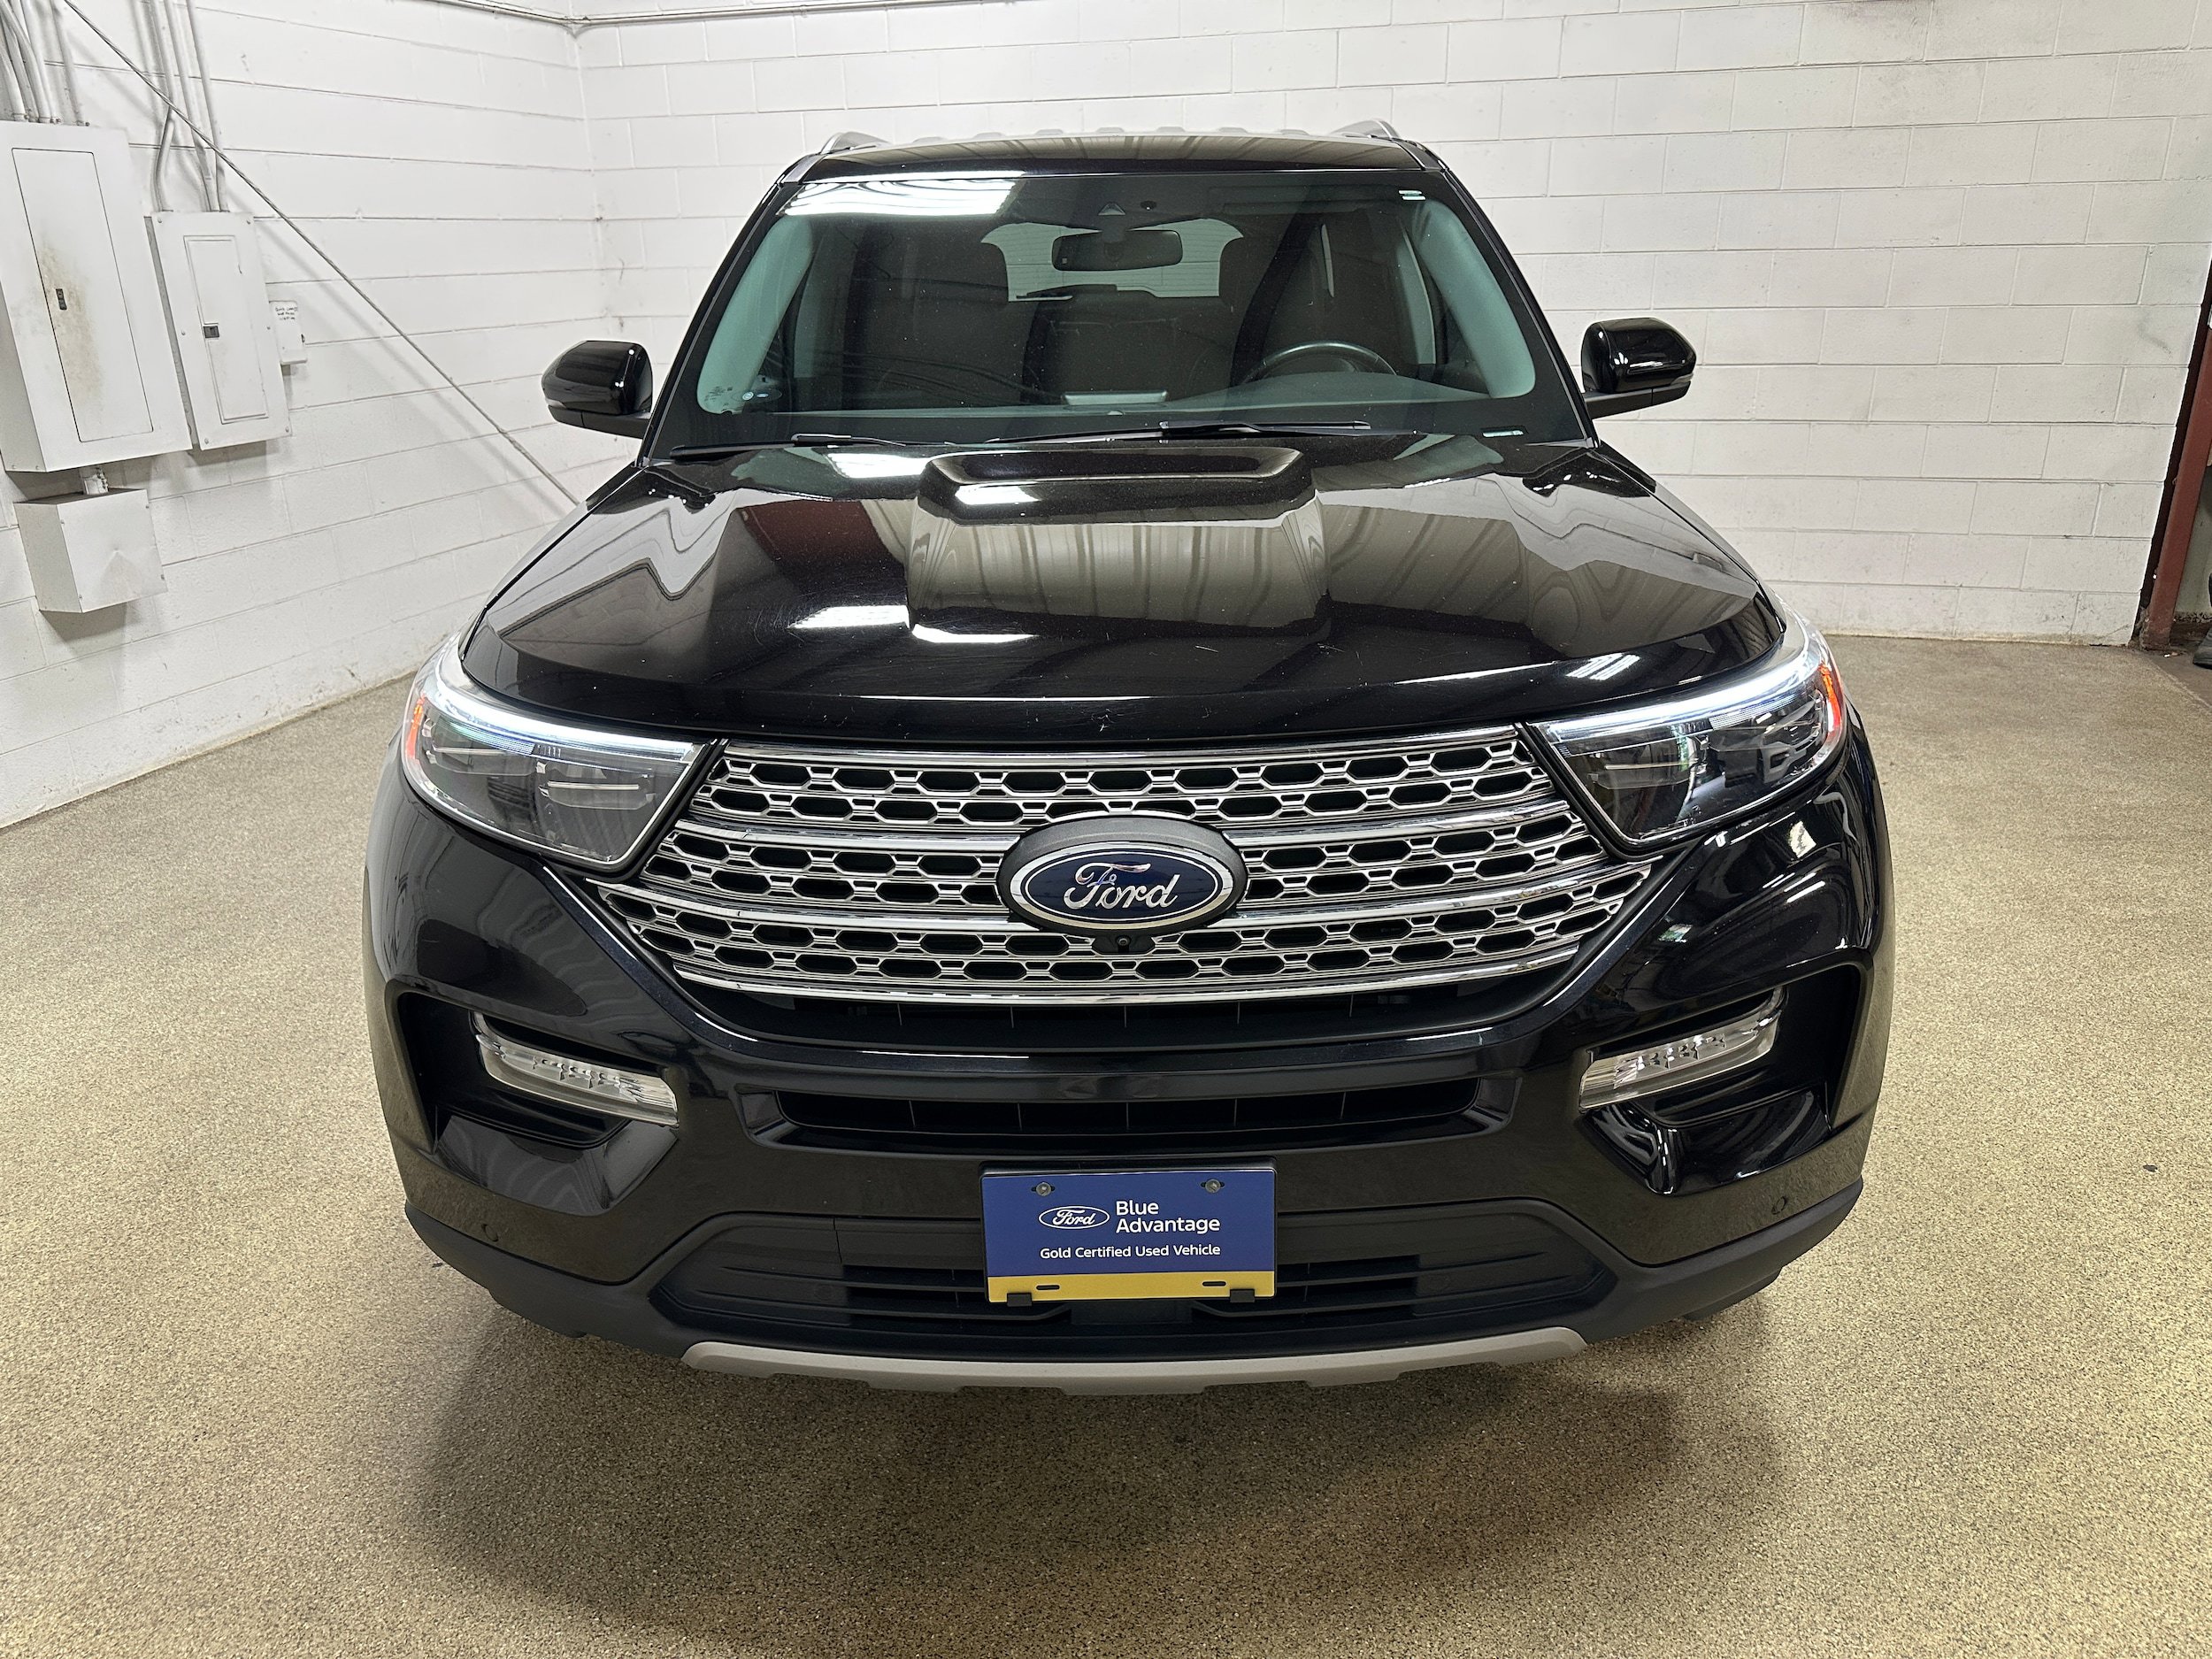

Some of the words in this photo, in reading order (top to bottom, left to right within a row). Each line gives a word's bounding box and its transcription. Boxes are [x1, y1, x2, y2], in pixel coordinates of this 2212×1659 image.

[1064, 862, 1180, 909] Ford
[1116, 1199, 1159, 1216] Blue
[1051, 1209, 1096, 1226] Ford
[1116, 1217, 1221, 1235] Advantage
[1040, 1247, 1071, 1259] Gold
[1075, 1246, 1132, 1258] Certified
[1135, 1244, 1170, 1257] Used
[1172, 1243, 1221, 1256] Vehicle
